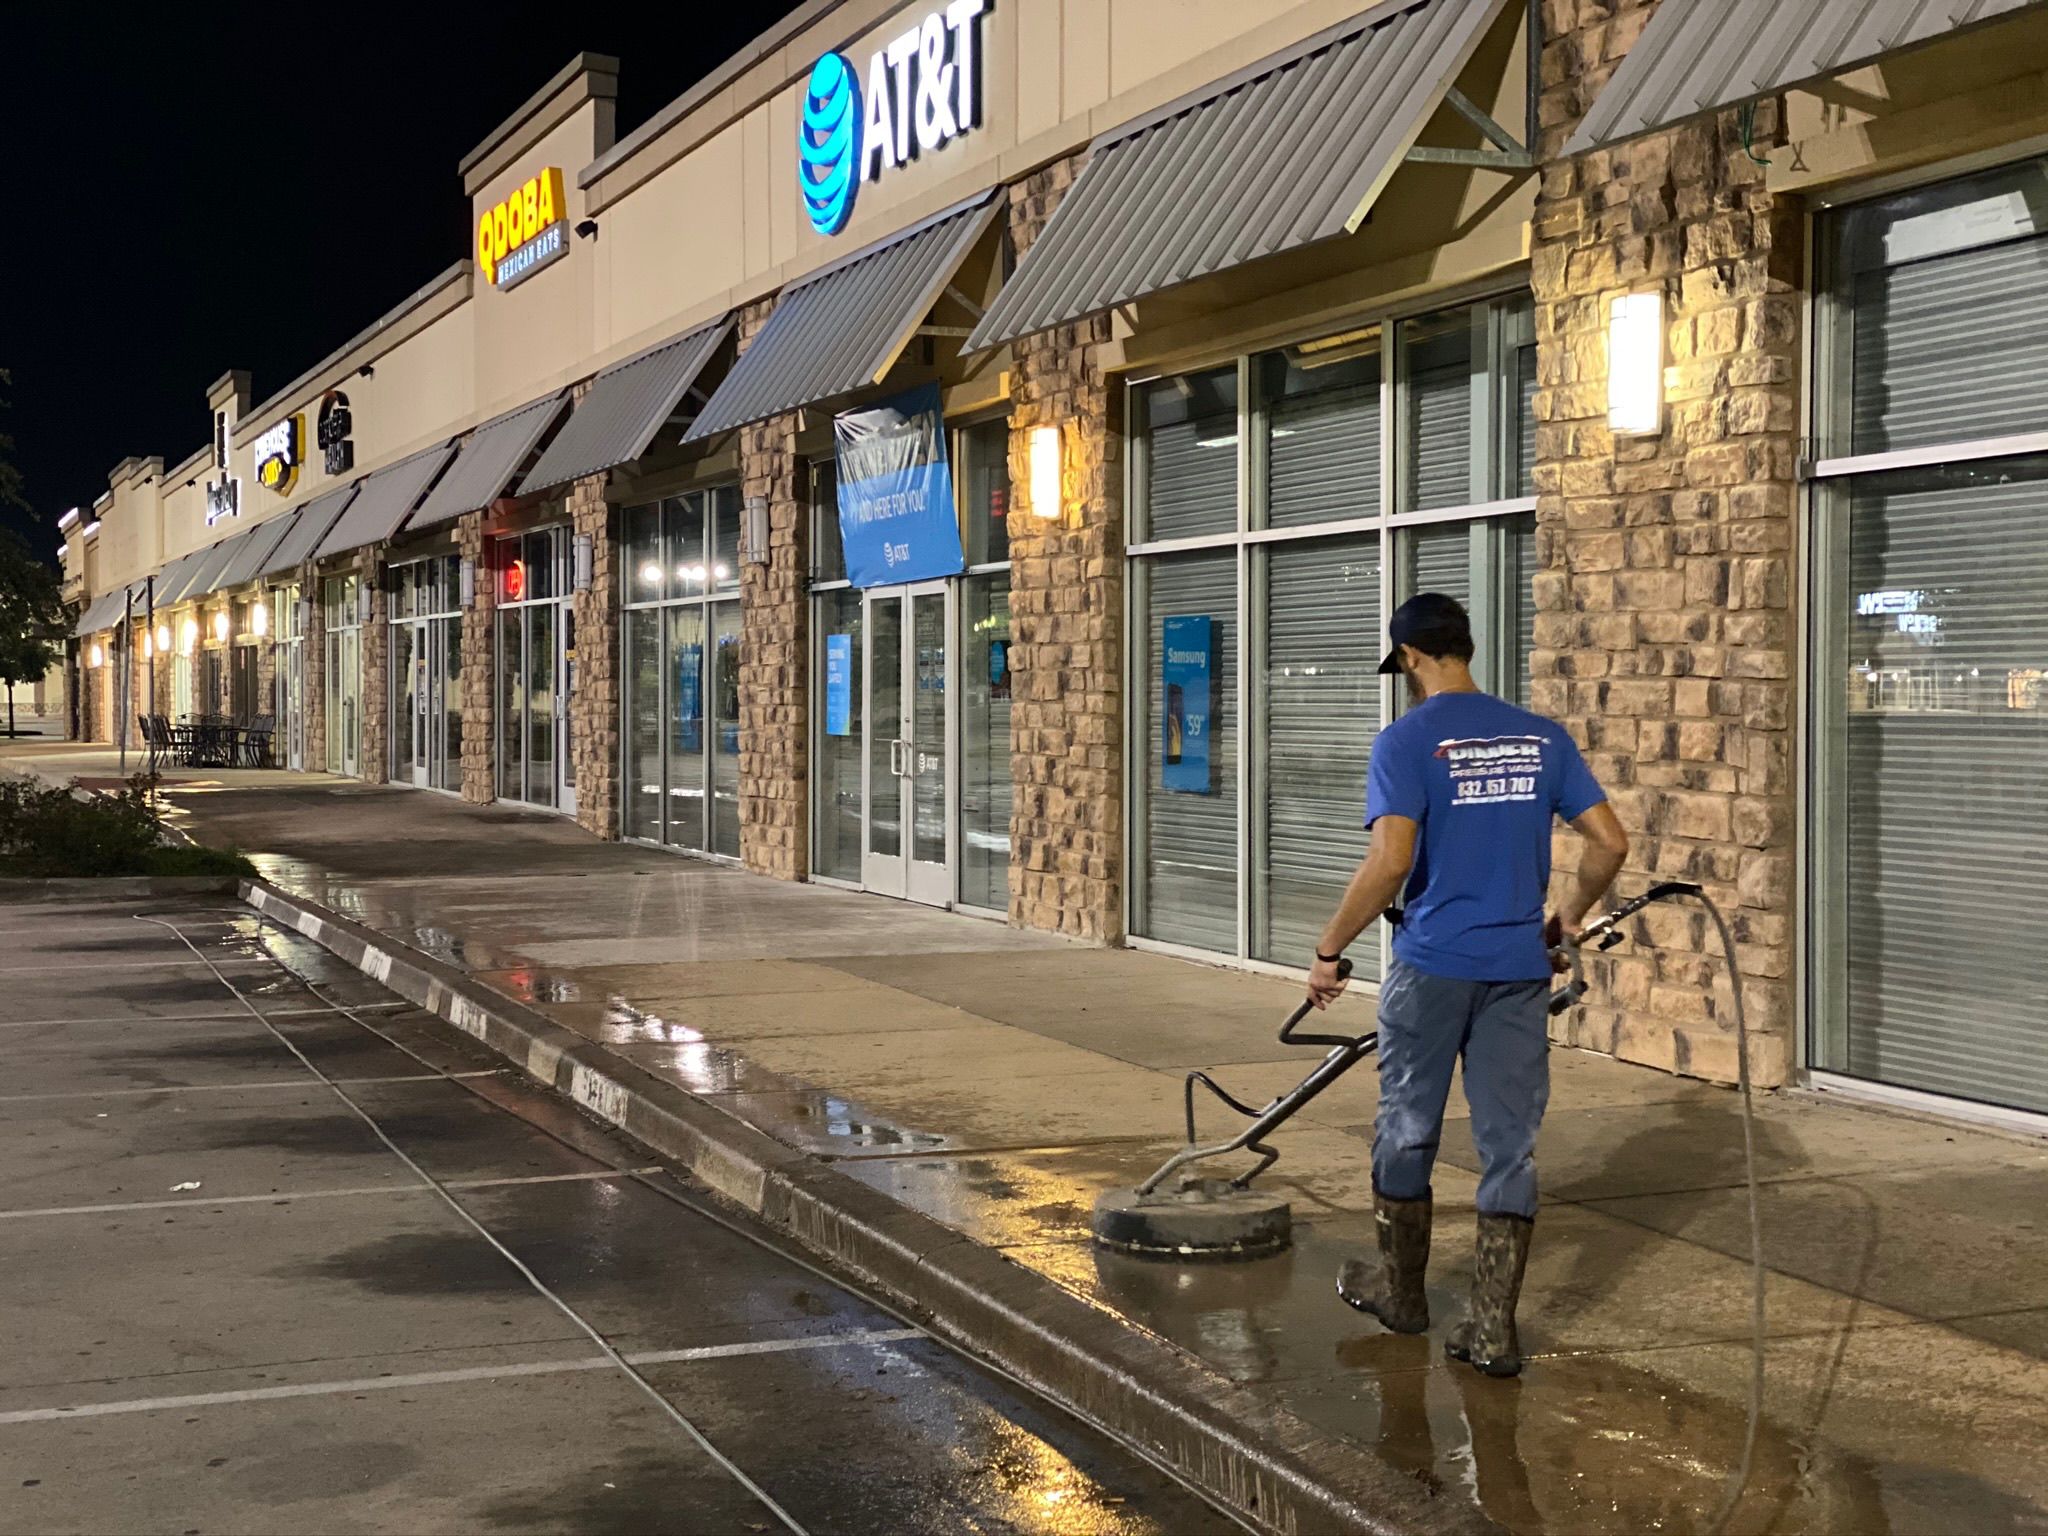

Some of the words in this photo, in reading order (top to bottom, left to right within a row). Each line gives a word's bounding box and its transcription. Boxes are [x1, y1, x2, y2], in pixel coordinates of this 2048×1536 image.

[860, 0, 984, 182] AT&T
[479, 167, 555, 285] QDOBA
[498, 244, 535, 284] MEXICAN
[537, 228, 559, 260] EATS
[874, 496, 892, 519] HERE
[892, 494, 907, 516] FOR
[894, 543, 909, 561] AT&T
[1167, 647, 1206, 668] Samsung
